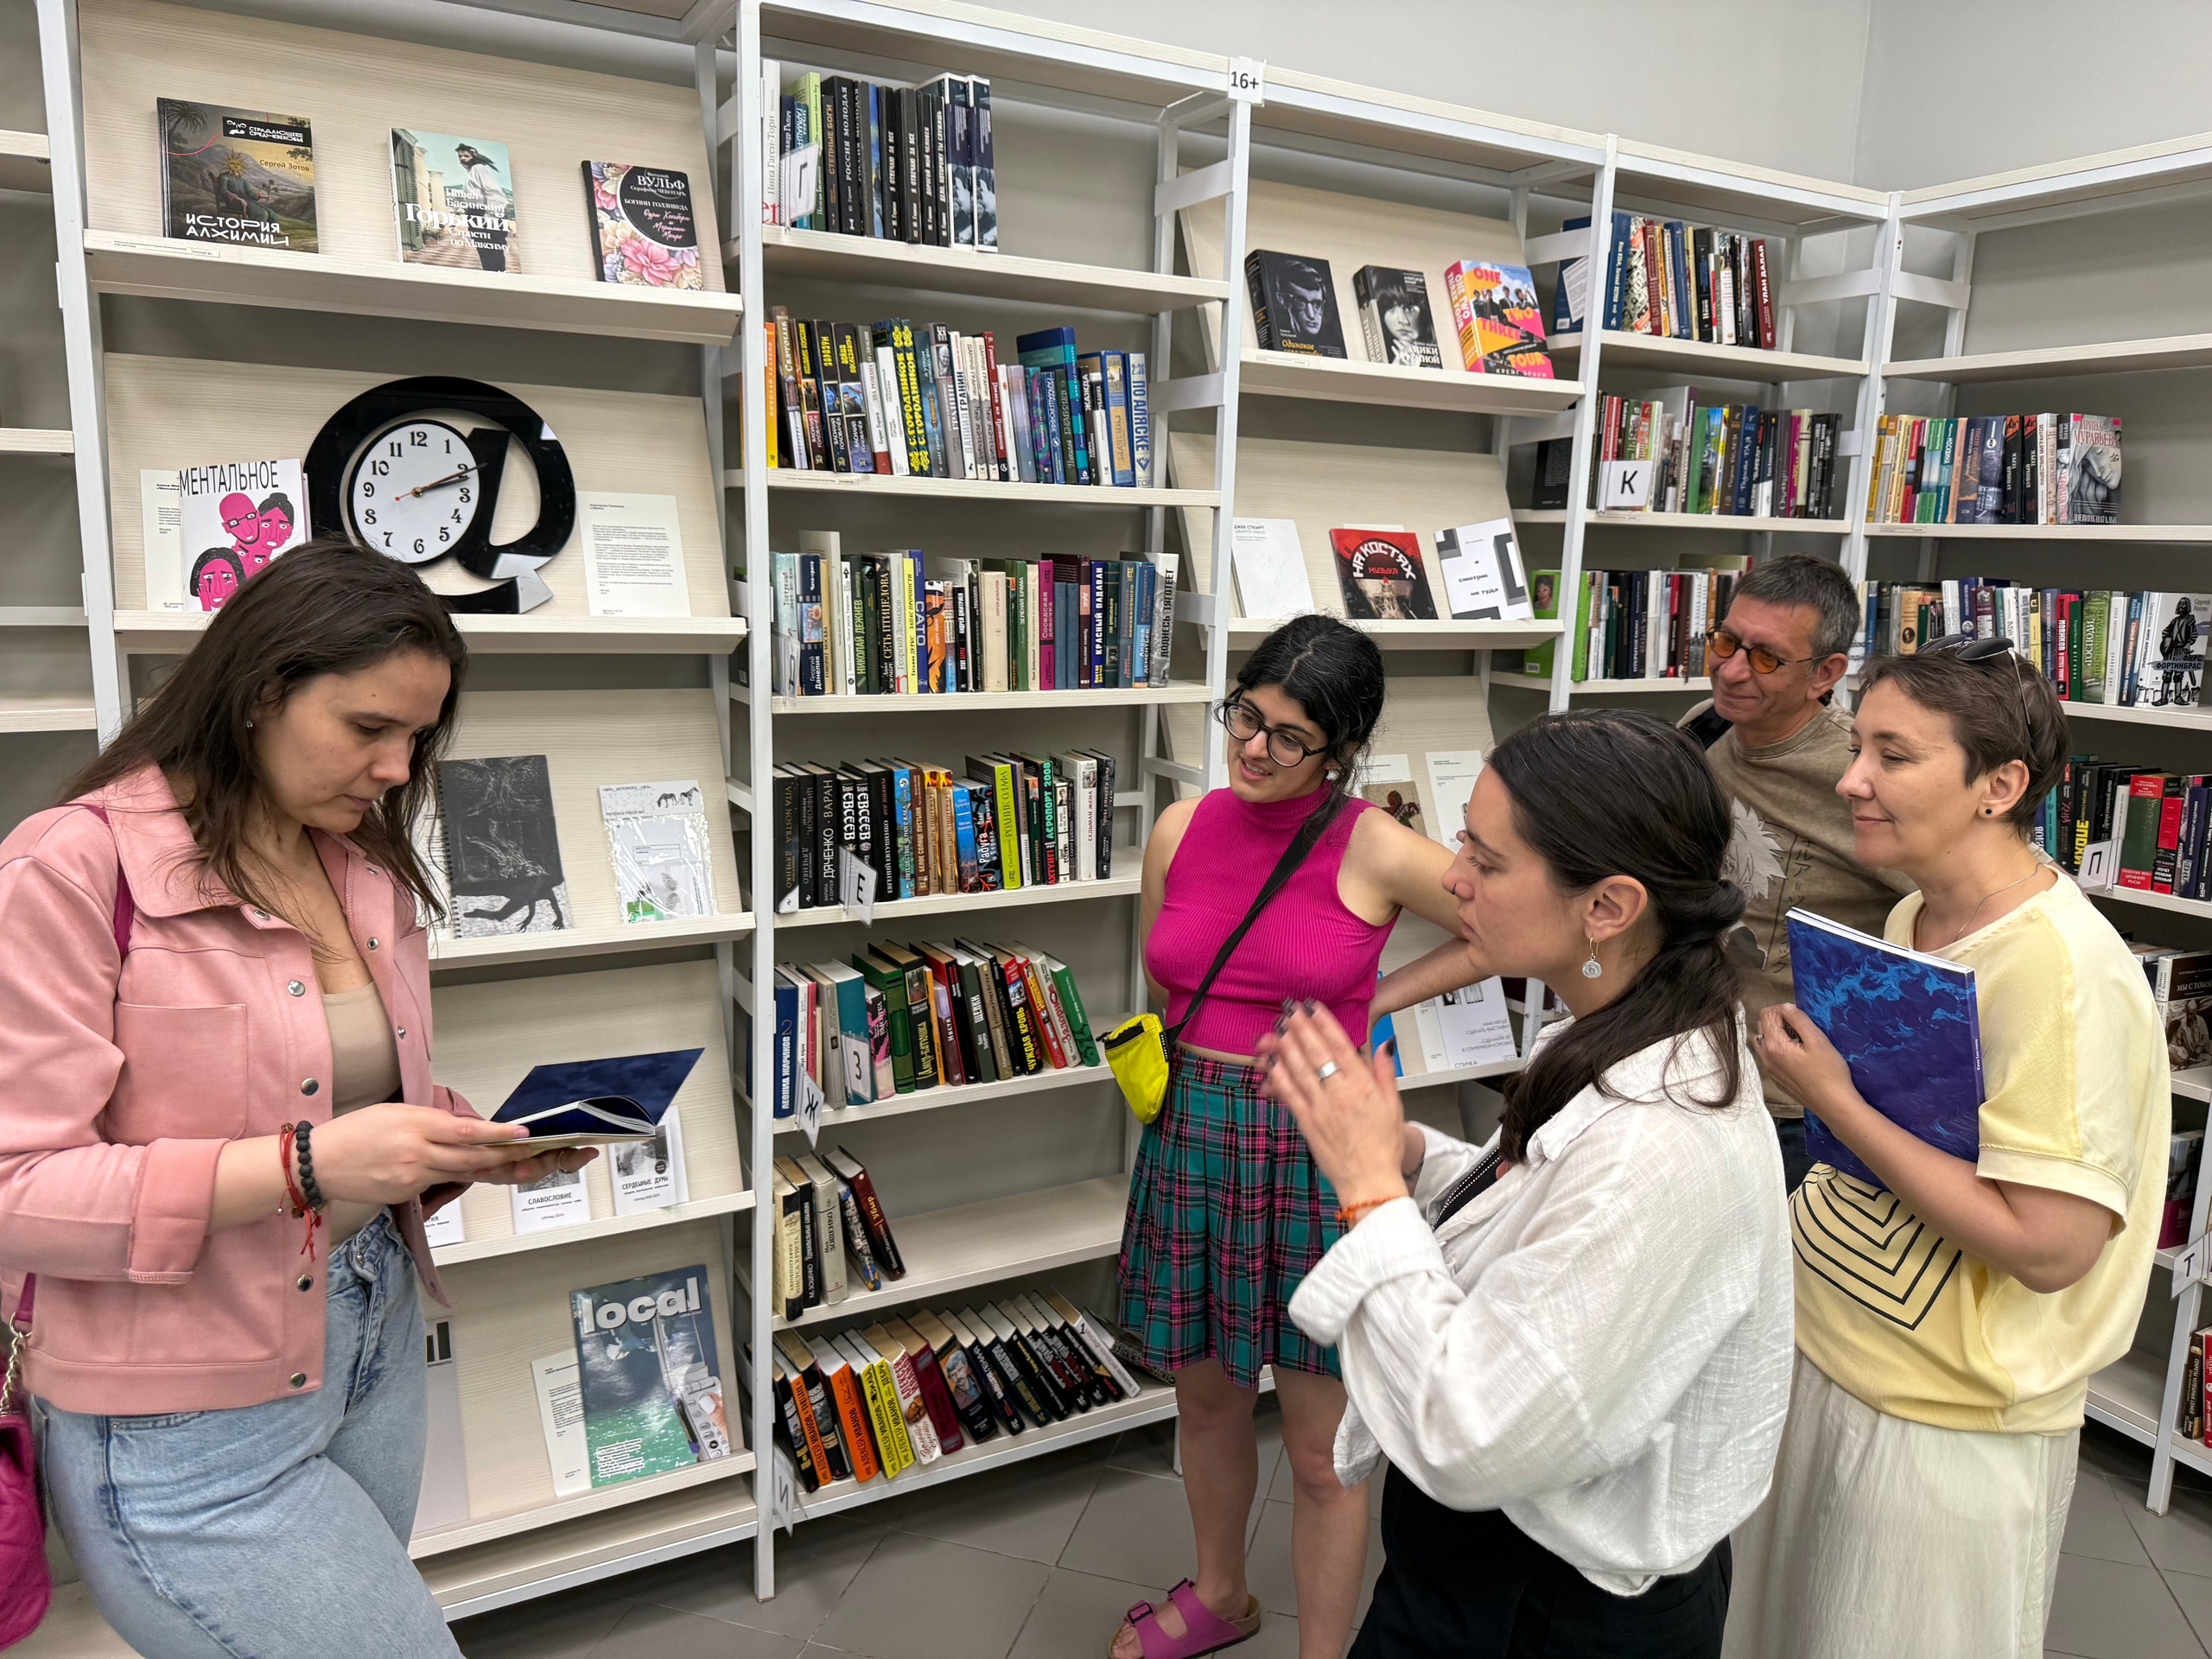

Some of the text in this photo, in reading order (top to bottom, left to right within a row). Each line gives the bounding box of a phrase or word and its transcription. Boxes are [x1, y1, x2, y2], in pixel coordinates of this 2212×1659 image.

[1230, 70, 1259, 89] 16+
[842, 86, 852, 181] РОССИЯ МОЛОДАЯ
[260, 159, 310, 172] Сергей Зотов
[446, 188, 478, 200] Павел
[637, 175, 685, 190] ВУЛЬФ
[766, 170, 776, 195] Нина
[404, 202, 511, 232] Горький
[447, 198, 505, 213] Басинский
[625, 198, 689, 212] БОГИНИ ГОЛЛИВУДА
[186, 213, 280, 234] ИСТОРИЯ
[448, 228, 492, 239] Страсти
[463, 239, 512, 253] Максиму
[1758, 245, 1767, 277] ДАЛАЙ
[1473, 266, 1502, 285] ONE
[1455, 274, 1471, 320] ONE TWO
[1453, 302, 1464, 331] FOUR
[1503, 307, 1535, 323] TWO
[1481, 320, 1522, 341] THREE
[1508, 352, 1547, 367] FOUR
[896, 352, 917, 447] С.ГОРОДНИКОВ
[906, 352, 926, 446] С.ГОРОДНИКОВ
[957, 371, 968, 411] ГРАНИН
[1082, 373, 1092, 411] ЖАЖДА
[1132, 380, 1150, 452] ПО АЛЯСКЕ
[389, 442, 403, 458] 11
[410, 431, 428, 448] 12
[444, 438, 452, 454] 1
[179, 460, 279, 498] МЕНТАЛЬНОЕ
[371, 460, 390, 476] 10
[363, 481, 375, 498] 9
[459, 487, 471, 503] 3
[364, 508, 378, 525] 8
[450, 508, 463, 524] 4
[383, 531, 394, 547] 7
[413, 538, 425, 554] 6
[439, 526, 450, 542] 5
[1351, 541, 1416, 580] НА КОСТЯХ
[1369, 566, 1399, 575] МУЗЫКА
[1459, 574, 1488, 582] смотрю
[880, 572, 893, 658] СЕТЬ ПТИЦЕЛОВА
[915, 601, 925, 646] САТО
[1095, 567, 1103, 655] КРАСНЫЙ ПАДАВАН
[1160, 569, 1173, 658] ДОДНЕСЬ ТЯГОТЕЕТ
[854, 599, 867, 675] НИКОЛАЙ ДЕЖНЕВ
[814, 655, 823, 690] Данелия
[2156, 662, 2202, 671] ФОРТИНБРАС
[1043, 761, 1052, 788] 2008
[1001, 770, 1013, 837] РОДНИК ОЛАФА
[823, 779, 835, 880] ДЯЧЕНКО ВАРАН
[978, 831, 991, 865] Радуга
[801, 847, 810, 885] ДЯЧЕНКО
[1046, 849, 1056, 885] АХТУНГ!
[970, 994, 984, 1024] ЩЕНКИ
[945, 1018, 955, 1041] Настя
[1017, 1007, 1037, 1071] ЧУЖДАЯ КРОВЬ
[781, 1035, 791, 1109] ЛЕОНИД ЖАРИКОВ
[654, 1175, 669, 1184] ДУМЫ
[527, 1192, 573, 1205] СЛАВОСЛОВИЕ
[867, 1196, 880, 1220] Убыр
[578, 1276, 701, 1333] local
[878, 1362, 910, 1457] АЛЕКСЕЙ ИВАНОВ ДЕБРИ
[804, 1414, 828, 1470] АЛЕКСЕЙ ИВАНОВ
[849, 1407, 872, 1468] АЛЕКСЕЙ ИВАНОВ
